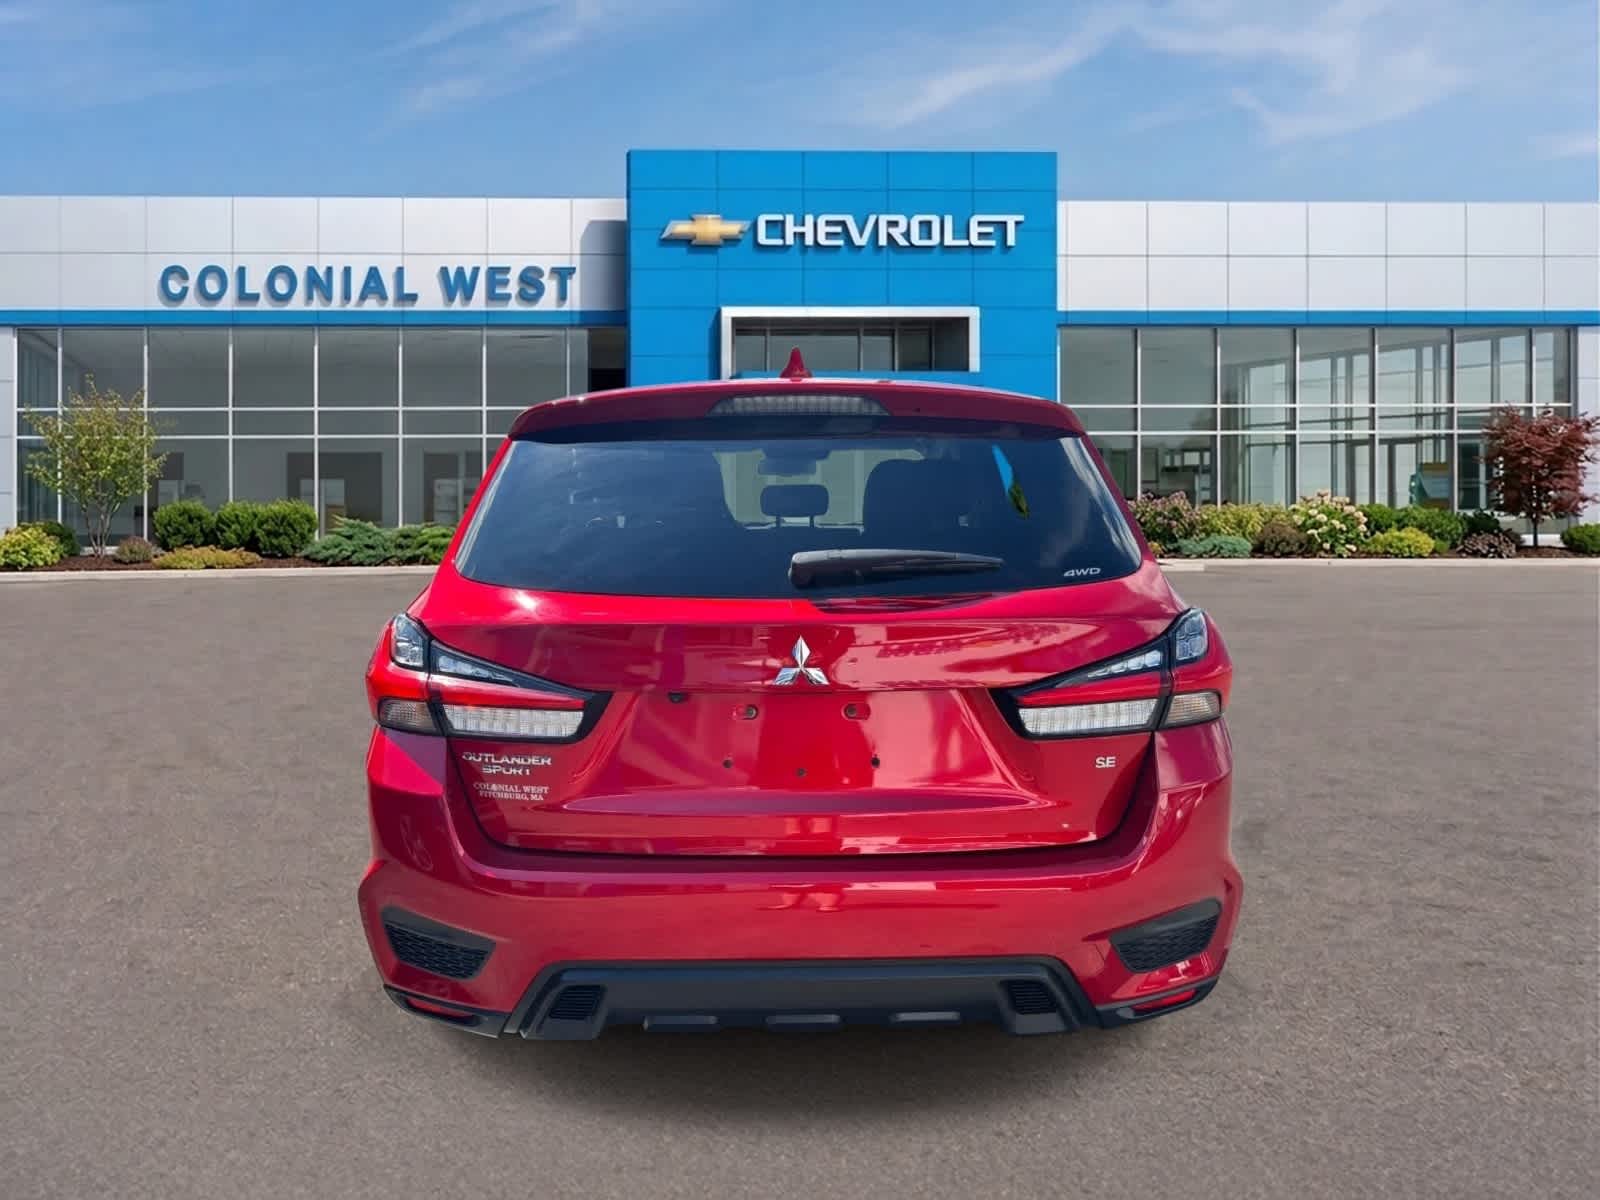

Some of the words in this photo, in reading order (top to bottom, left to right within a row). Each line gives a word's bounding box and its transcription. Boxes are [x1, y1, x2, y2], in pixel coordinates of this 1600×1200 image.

[757, 214, 1024, 247] CHEVROLET
[160, 265, 418, 305] COLONIAL
[438, 266, 576, 304] WEST
[1063, 567, 1102, 577] 4WD
[462, 751, 552, 766] OUTLANDER
[1095, 756, 1116, 768] SE
[482, 765, 530, 775] SPORT
[473, 782, 521, 793] COLONIAL
[523, 785, 549, 794] WEST
[530, 793, 544, 801] MA
